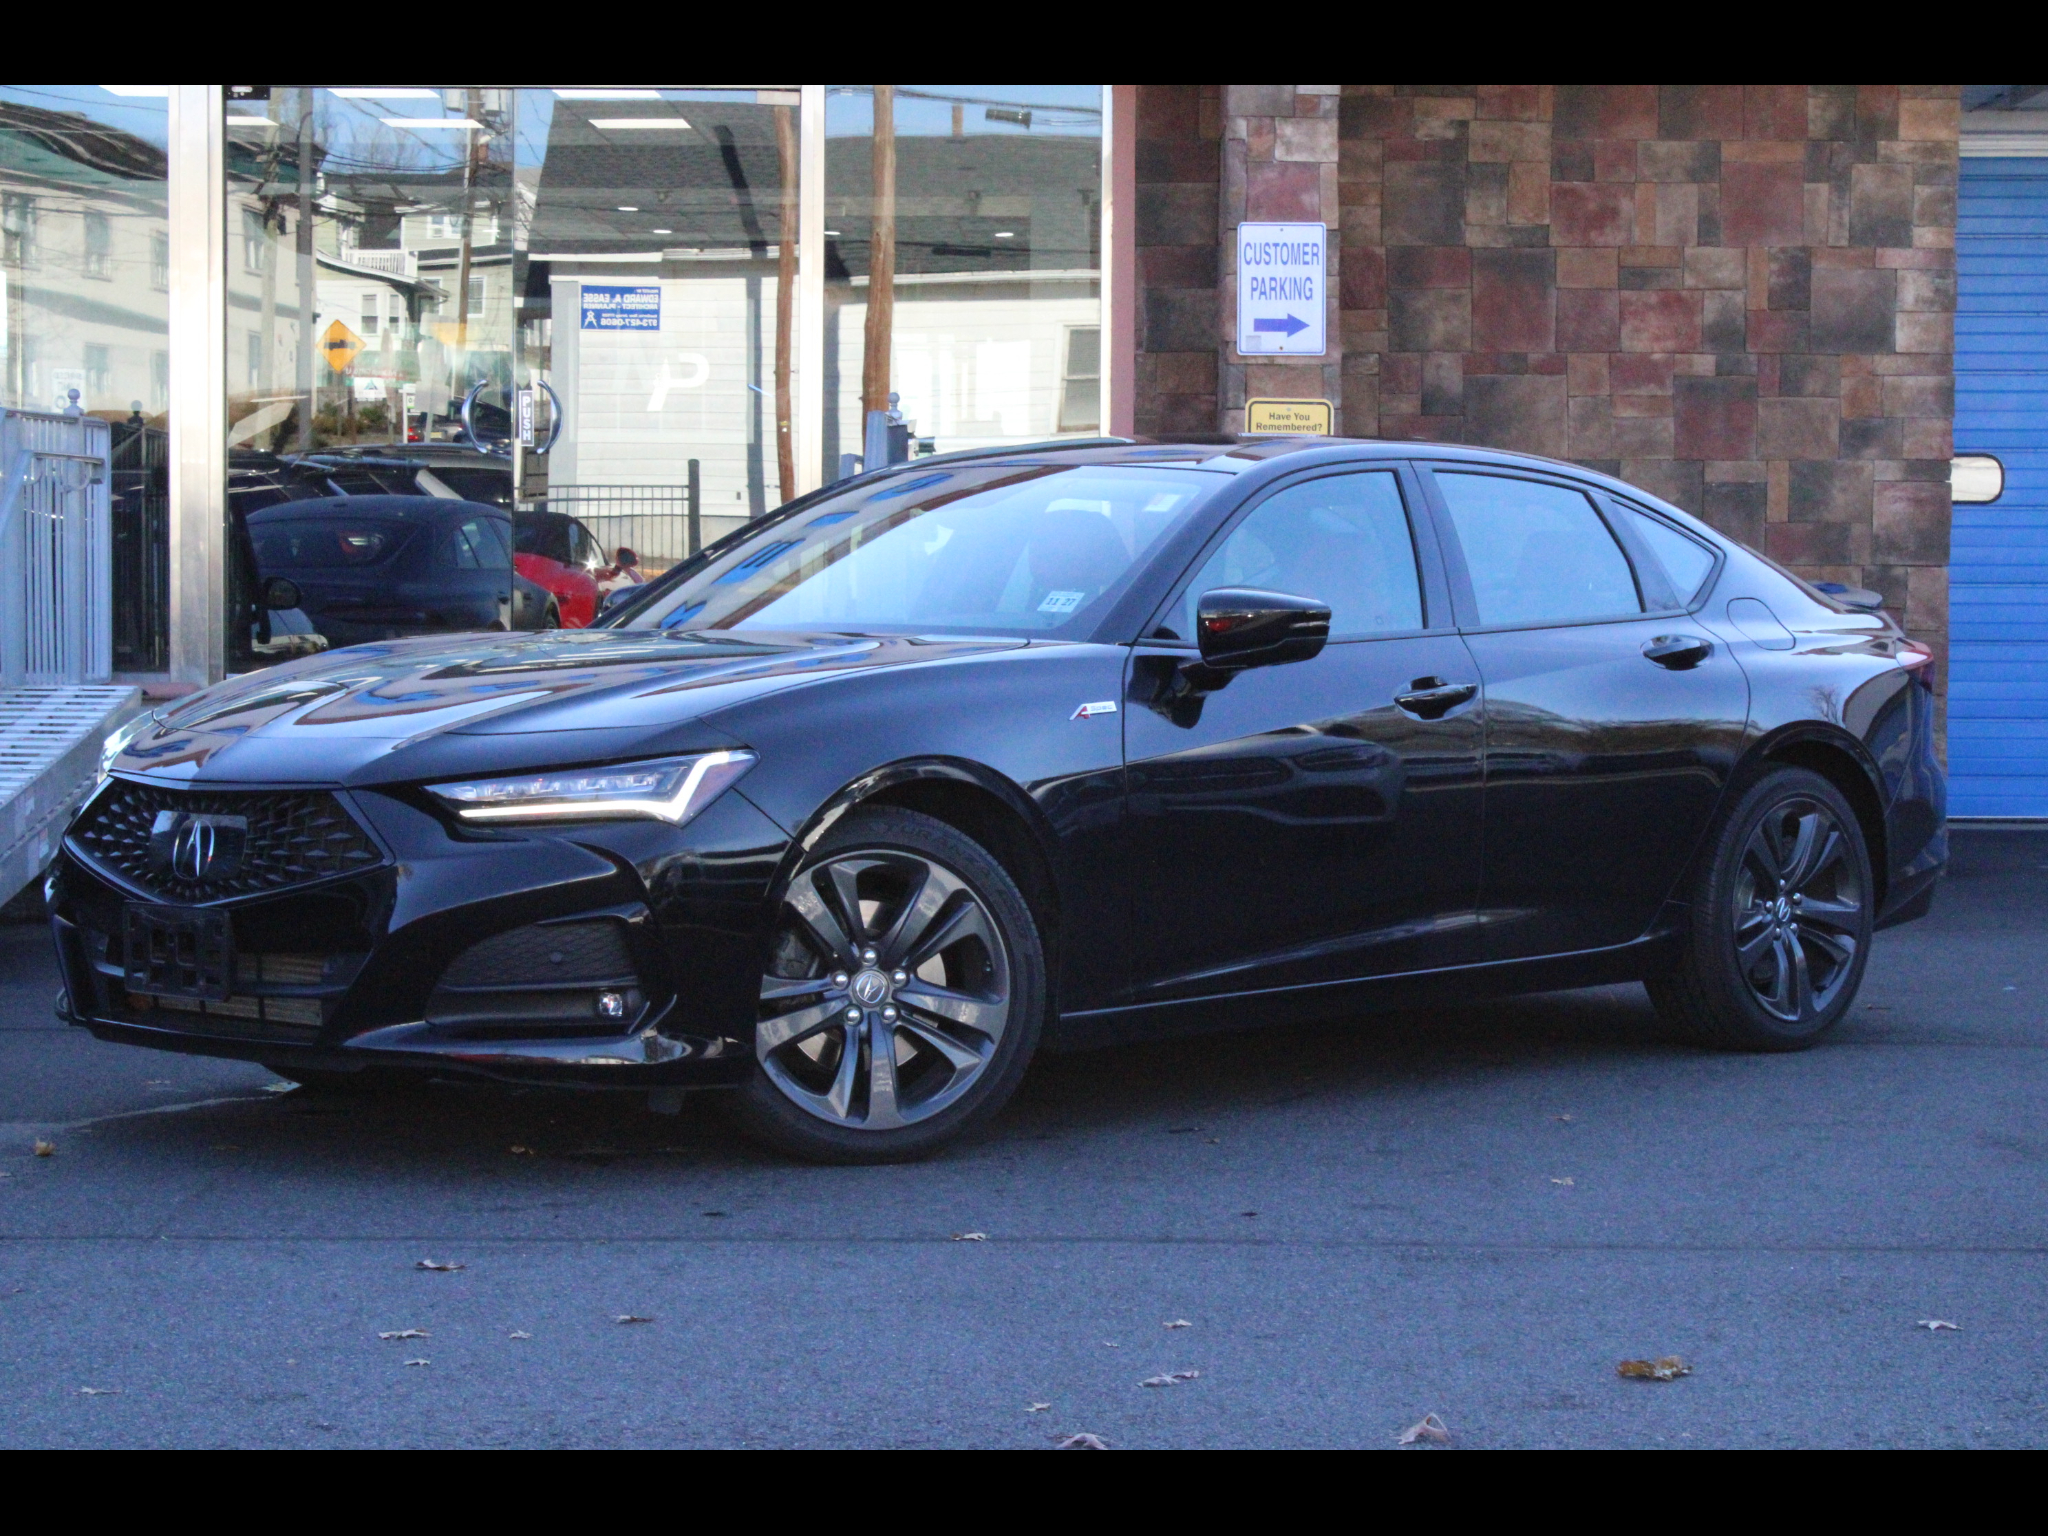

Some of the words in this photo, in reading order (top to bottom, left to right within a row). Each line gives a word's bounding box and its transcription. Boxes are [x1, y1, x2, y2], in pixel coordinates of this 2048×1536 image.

[1243, 242, 1320, 266] CUSTOMER
[1250, 276, 1313, 301] PARKING
[522, 395, 531, 441] PUSH
[1269, 412, 1291, 421] Have
[1294, 412, 1310, 421] You
[1256, 422, 1323, 432] Remembered?
[1045, 597, 1060, 606] 11
[1061, 597, 1077, 606] 27
